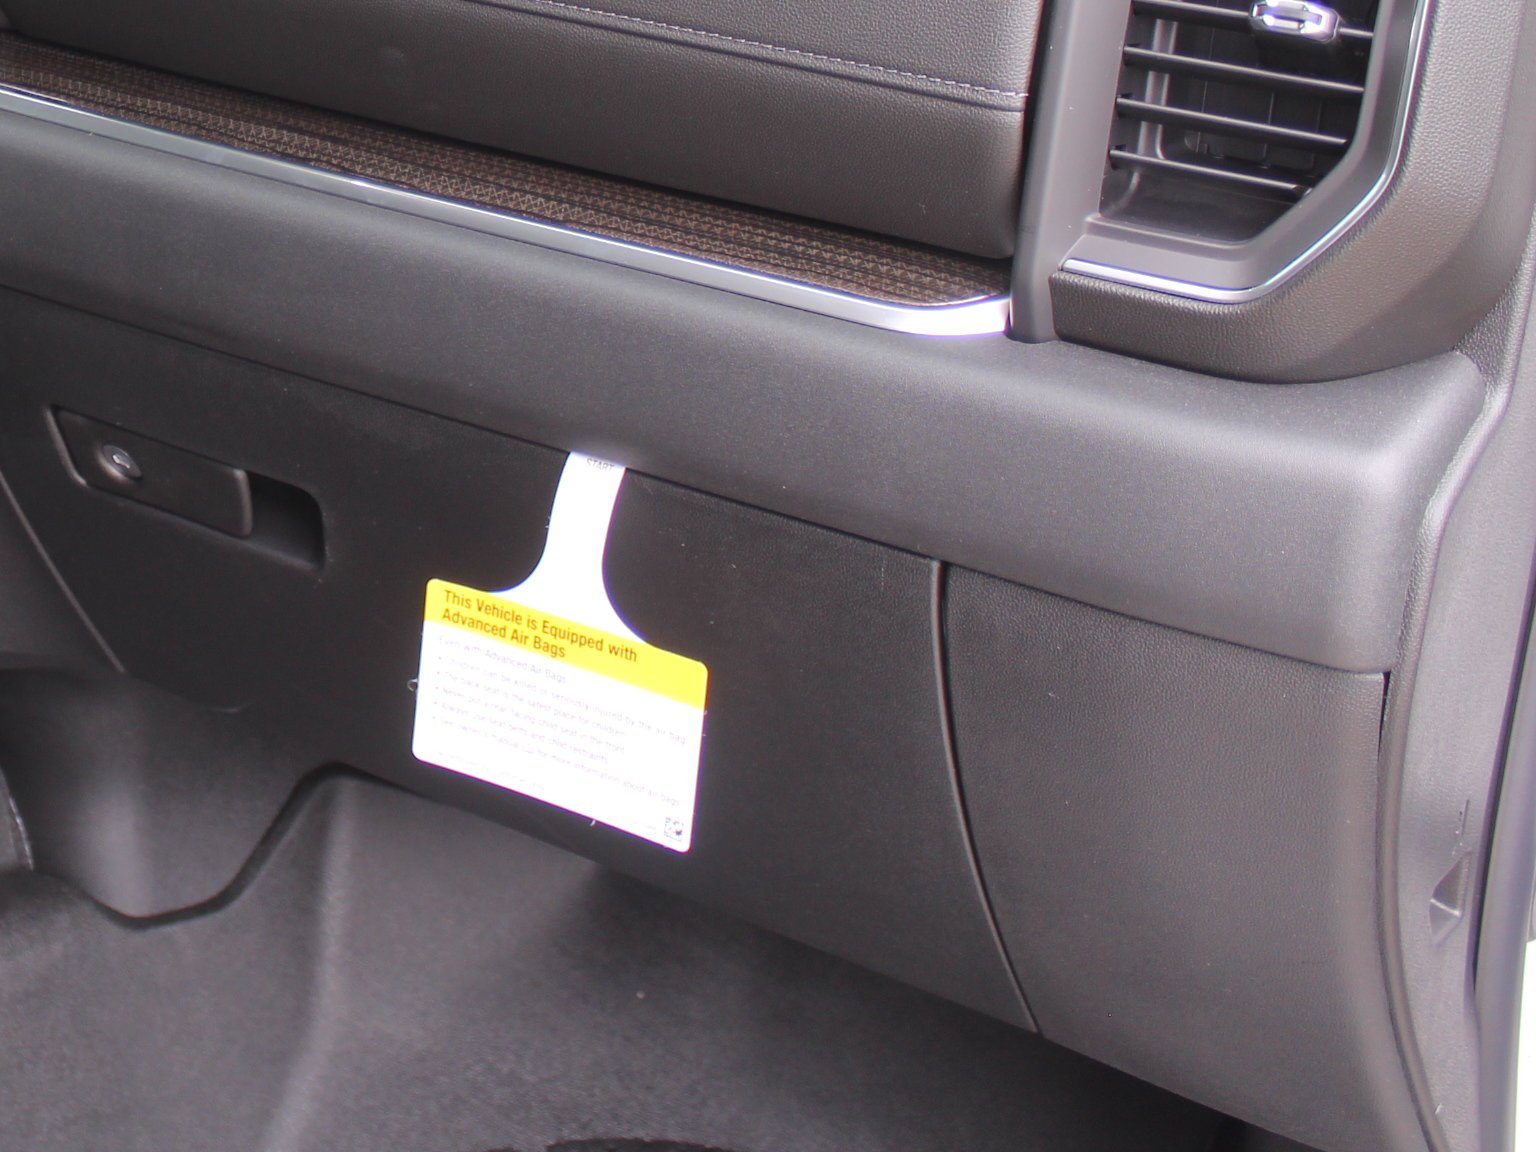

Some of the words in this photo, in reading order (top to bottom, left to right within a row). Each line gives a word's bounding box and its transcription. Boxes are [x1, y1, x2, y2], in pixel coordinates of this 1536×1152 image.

[586, 458, 615, 472] START
[441, 607, 507, 638] Advanced
[509, 629, 529, 645] Air
[531, 636, 566, 659] Bags
[443, 589, 472, 610] This
[475, 599, 522, 626] Vehicle
[526, 615, 538, 631] is
[540, 620, 603, 652] Equipped
[607, 642, 638, 663] with
[483, 649, 528, 670] Advanced
[544, 668, 567, 685] Bags
